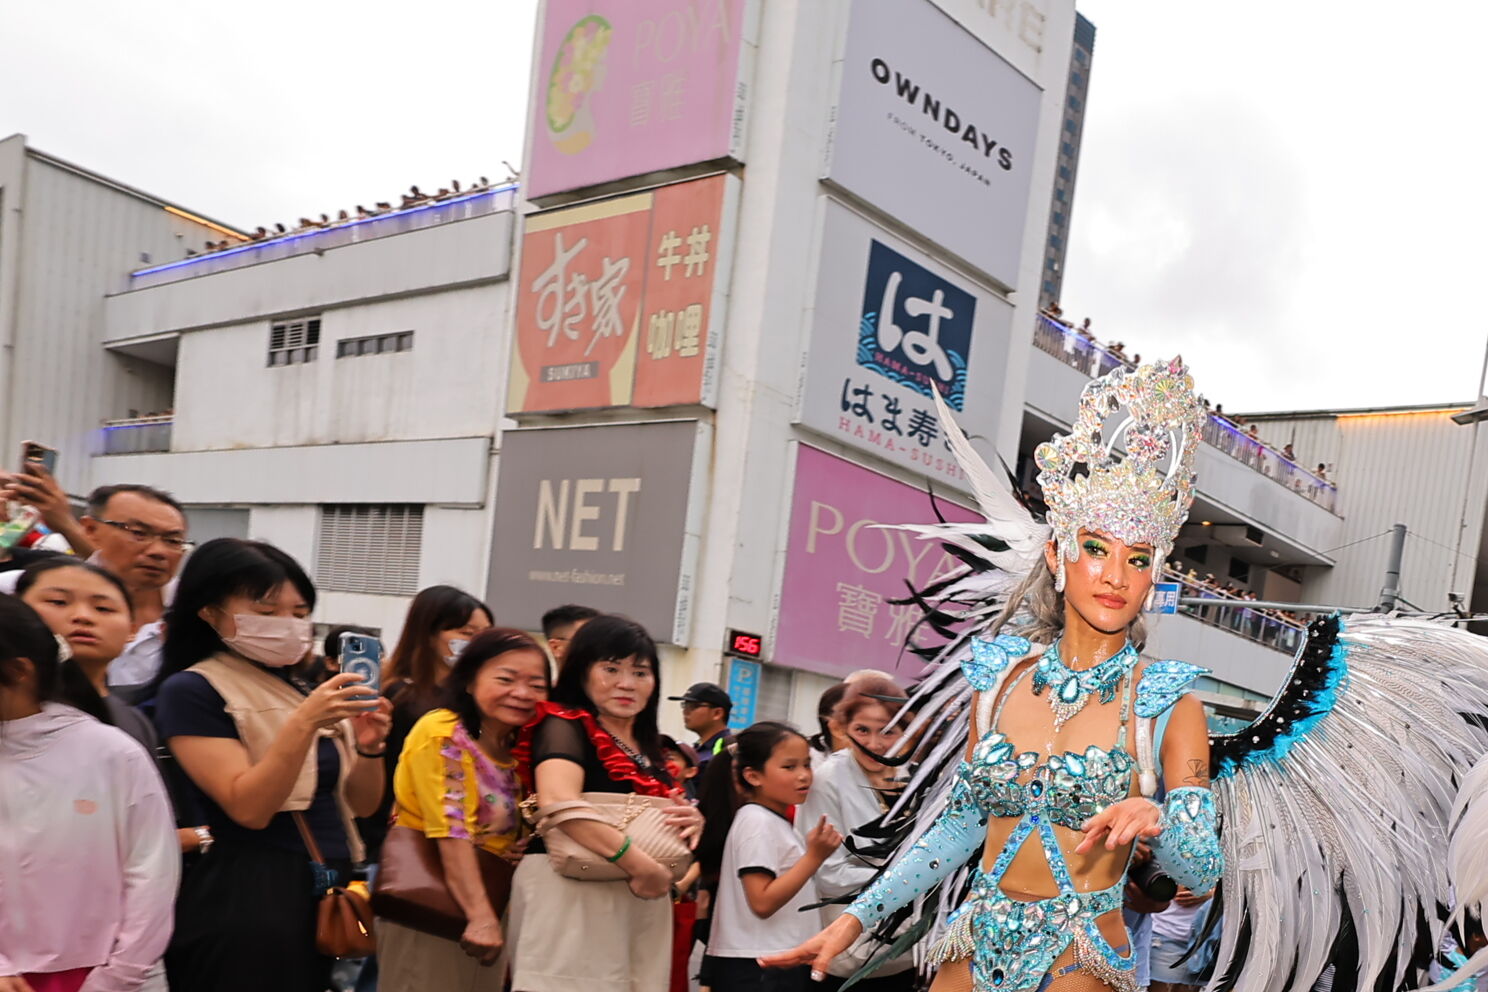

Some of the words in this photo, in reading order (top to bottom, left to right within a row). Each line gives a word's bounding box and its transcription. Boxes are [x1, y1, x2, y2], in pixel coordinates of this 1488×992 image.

[870, 58, 1013, 171] OWNDAYS
[656, 224, 713, 281] 牛丼
[531, 231, 631, 358] すき家
[877, 271, 954, 382] は
[546, 363, 592, 381] SUKIYA
[533, 478, 642, 551] NET
[733, 635, 761, 655] 156
